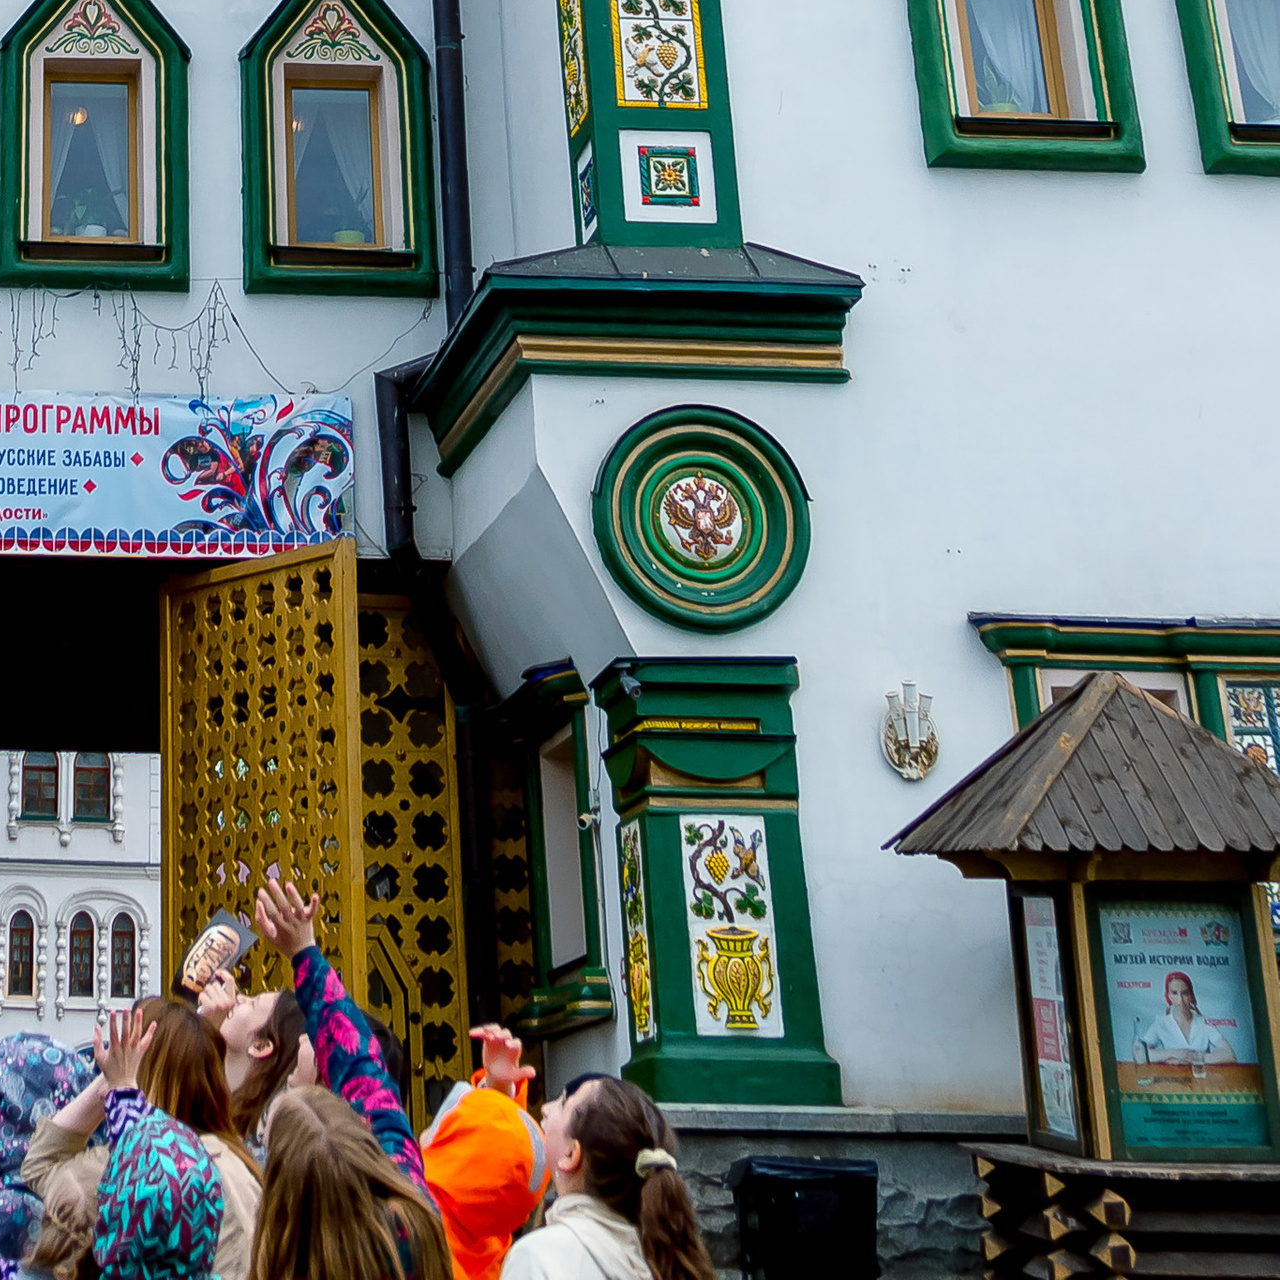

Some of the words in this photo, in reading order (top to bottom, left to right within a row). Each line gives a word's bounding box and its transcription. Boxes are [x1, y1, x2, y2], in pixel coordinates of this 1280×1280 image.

[62, 449, 126, 468] ЗАБАВЫ
[1114, 952, 1147, 965] МУЗЕЙ
[1149, 954, 1194, 966] ИСТОРИИ
[1196, 955, 1230, 968] ВОДКИ
